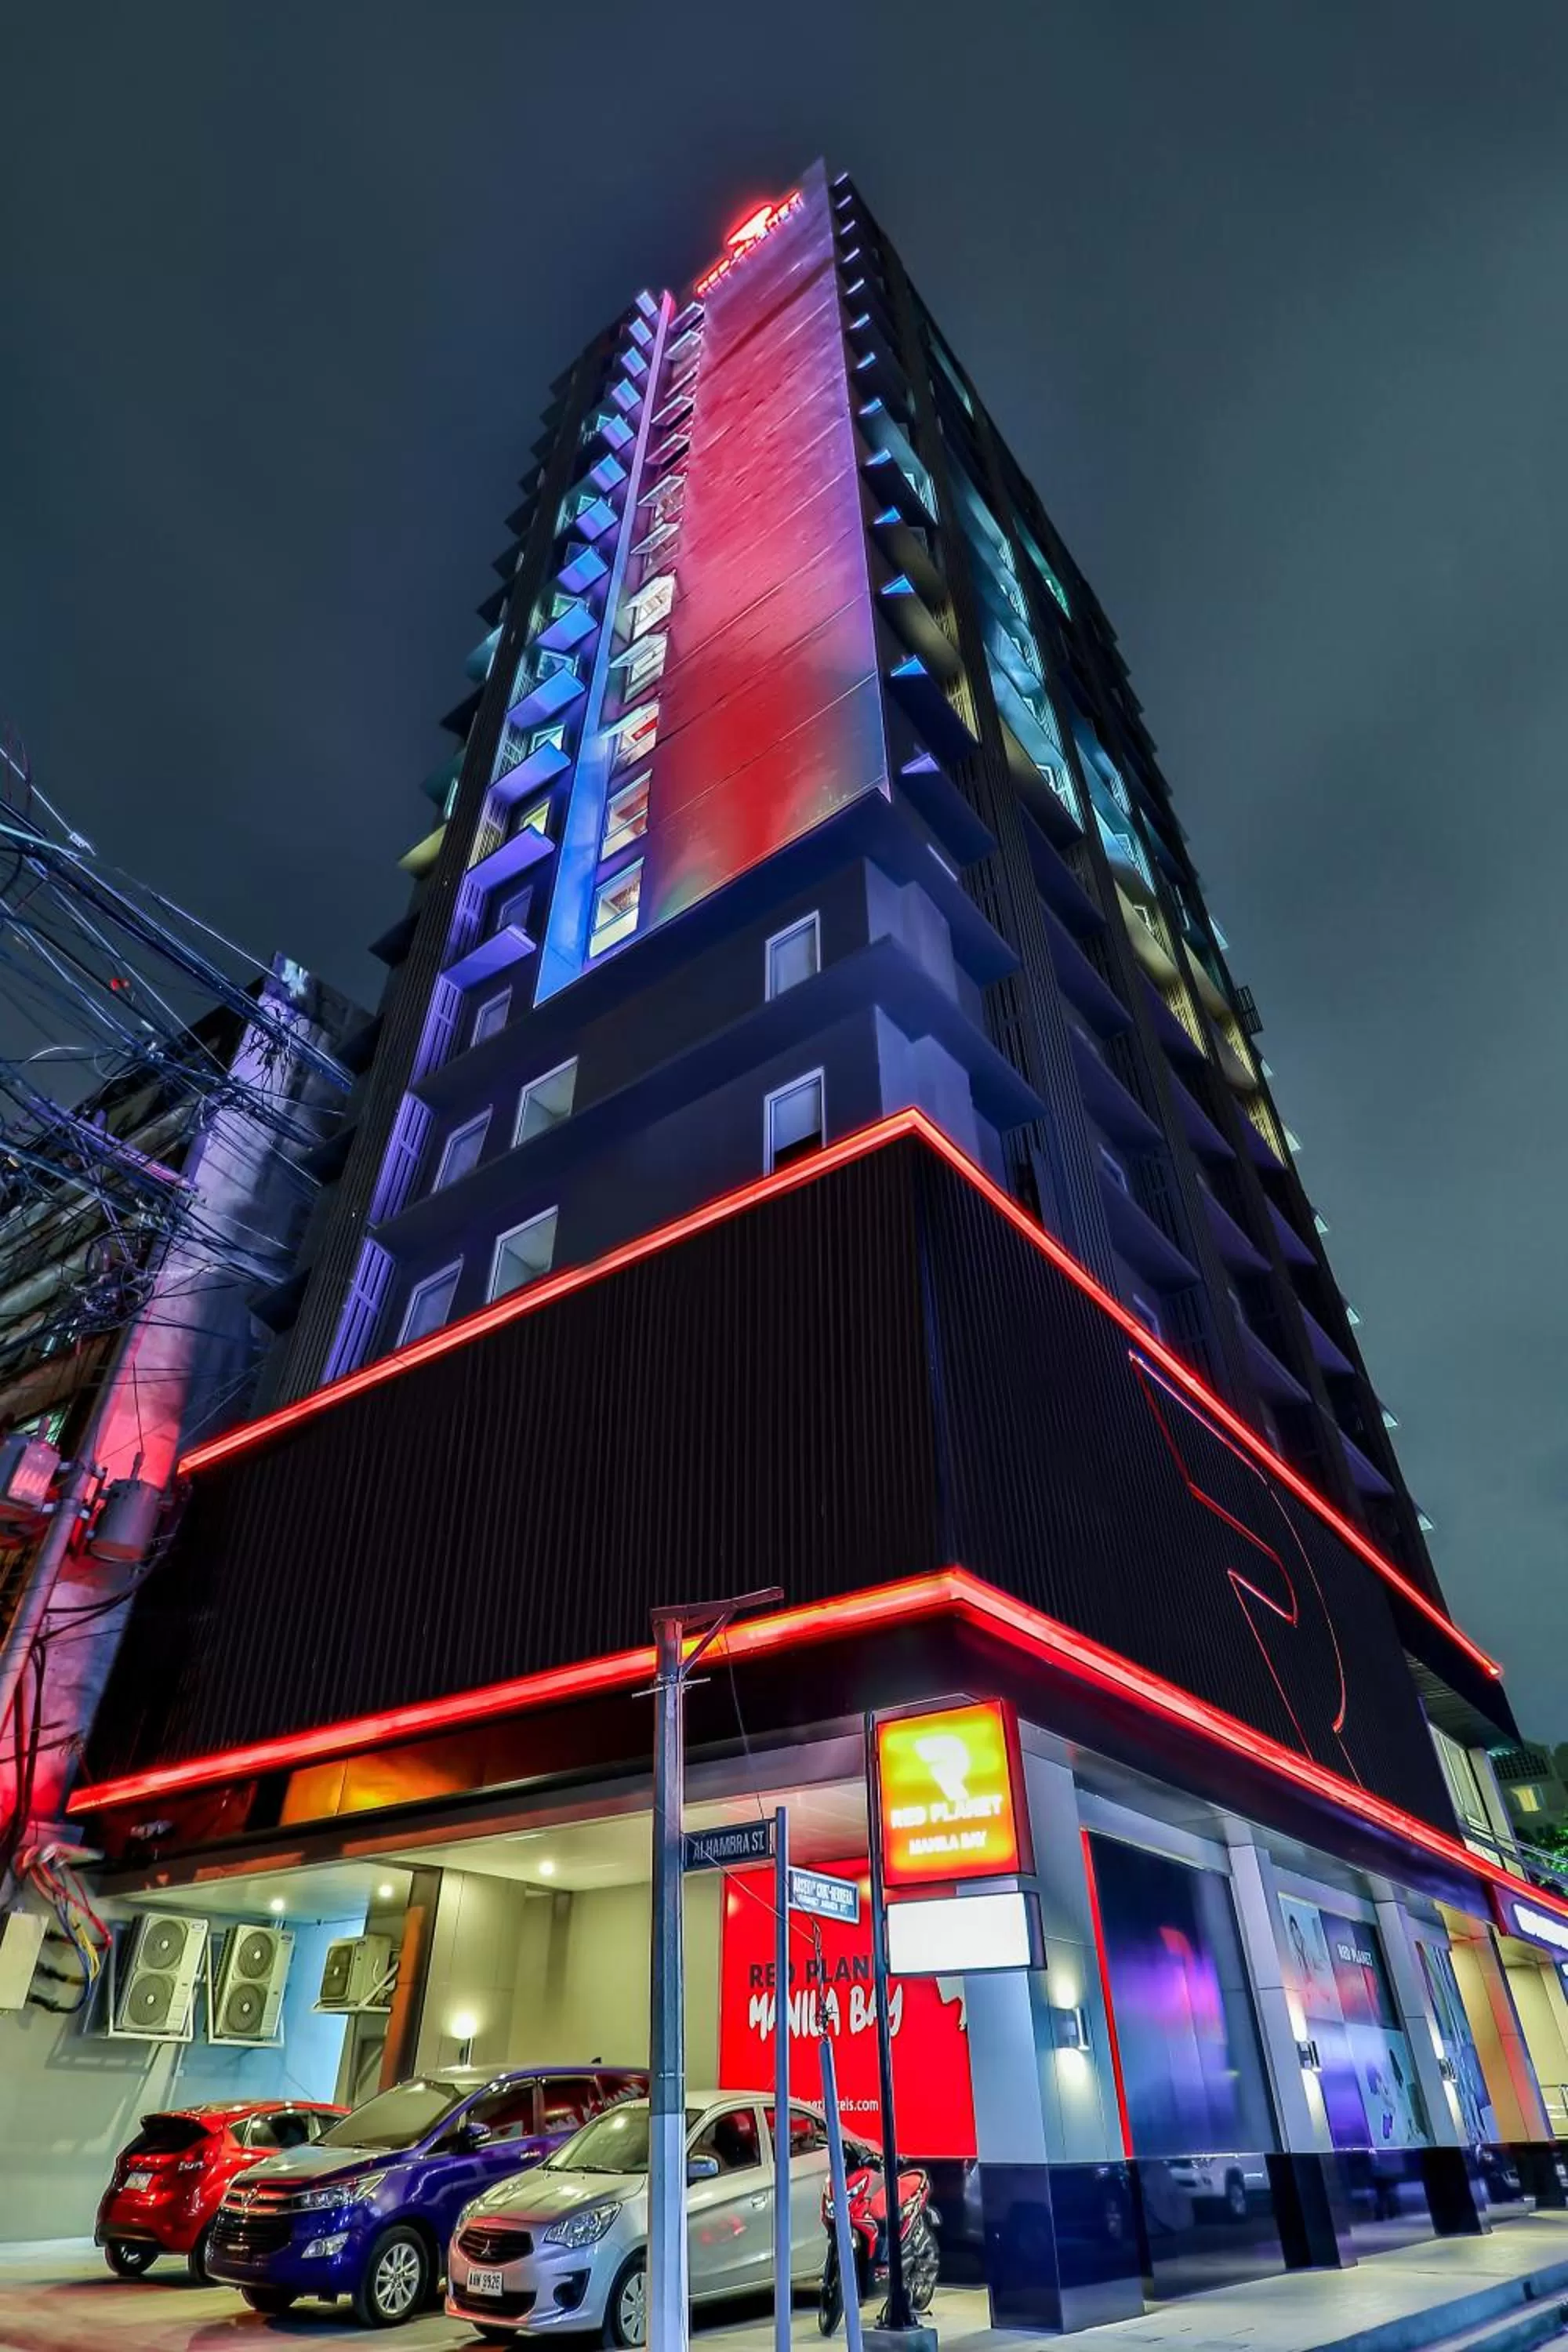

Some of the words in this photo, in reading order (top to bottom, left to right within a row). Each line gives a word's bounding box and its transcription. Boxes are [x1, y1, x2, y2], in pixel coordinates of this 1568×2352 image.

[891, 1806, 926, 1829] RED
[692, 1834, 750, 1861] ALHAMBRA
[805, 1955, 876, 1984] PLAN
